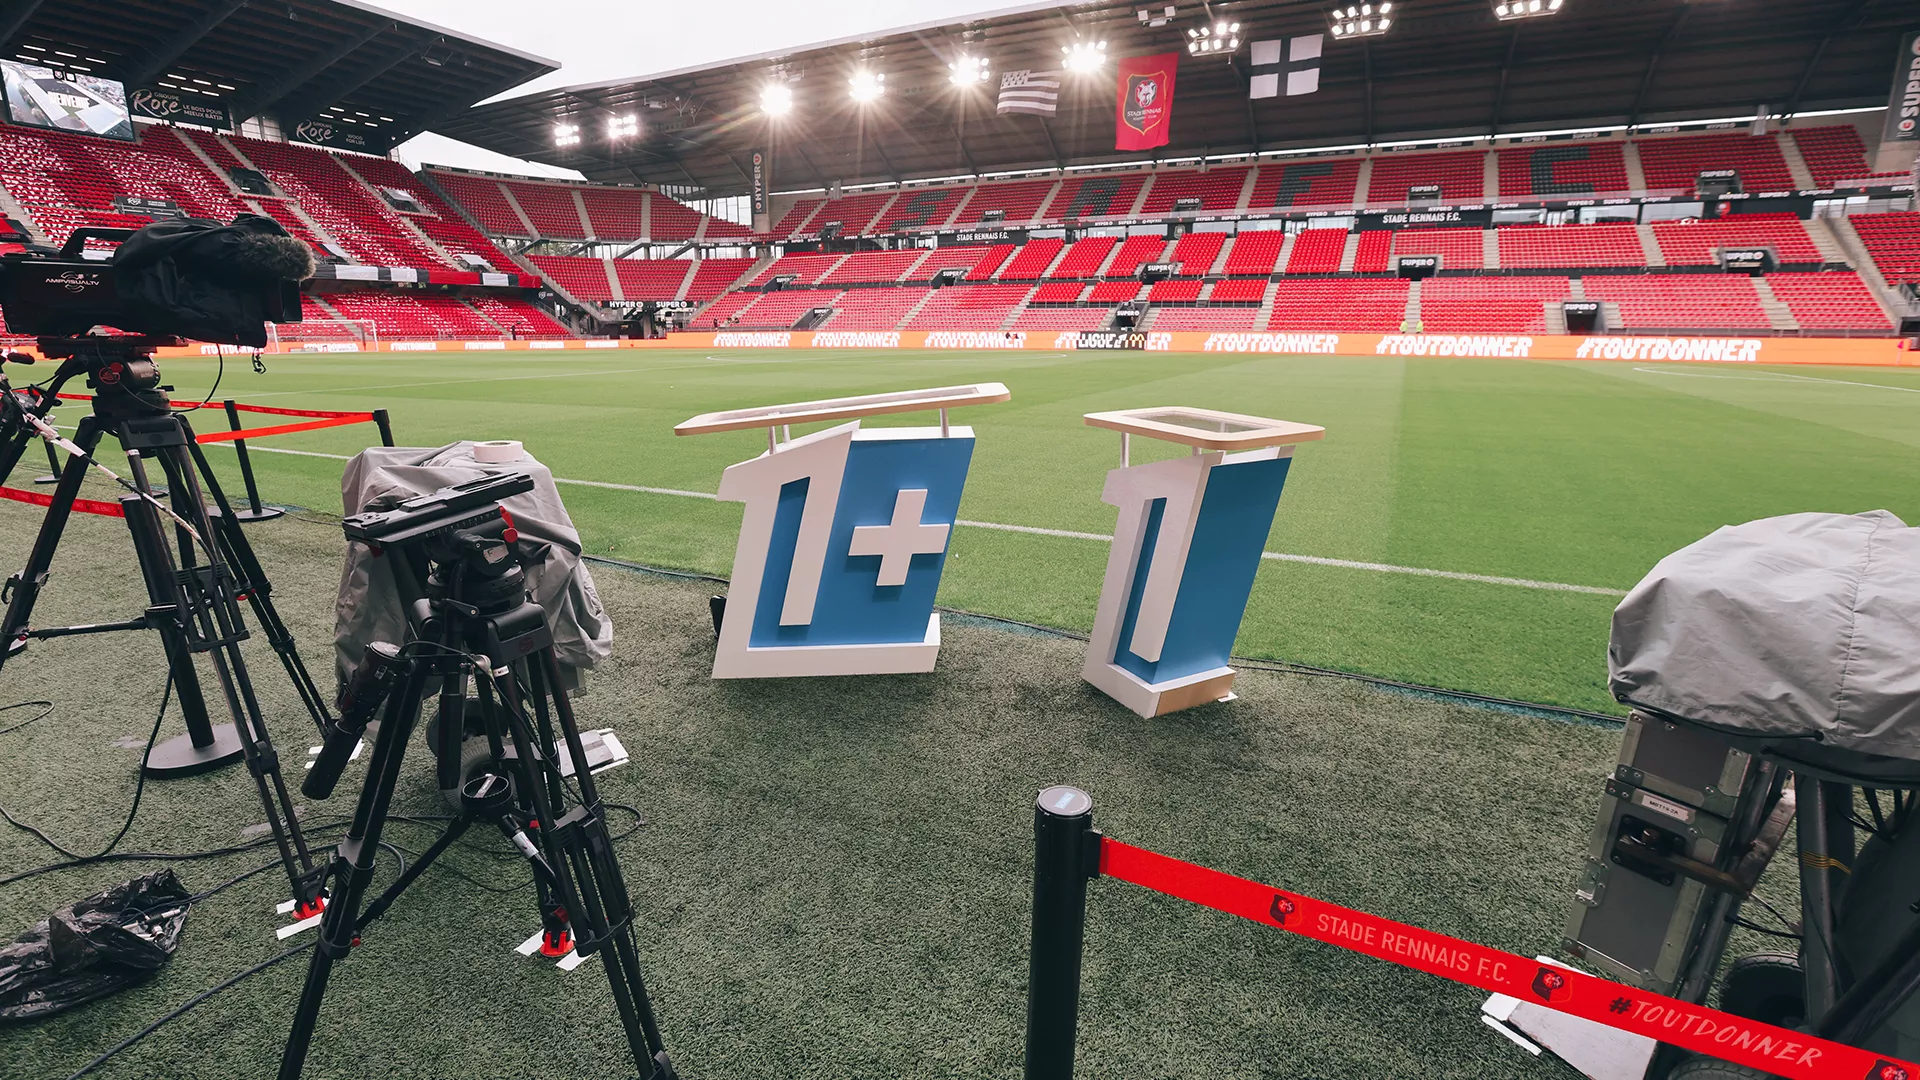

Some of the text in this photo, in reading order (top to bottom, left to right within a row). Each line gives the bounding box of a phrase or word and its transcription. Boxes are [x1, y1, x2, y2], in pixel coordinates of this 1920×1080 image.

[130, 89, 182, 117] Rose
[191, 105, 205, 113] BOIS
[296, 119, 334, 144] Rose
[1383, 212, 1461, 224] STADE RENNAIS F.C.
[714, 332, 790, 347] #TOUTDONNER
[812, 332, 900, 347] #TOUTDONNER
[1204, 334, 1338, 354] #TOUTDONNER
[1376, 336, 1532, 357] #TOUTDONNER
[1576, 338, 1762, 361] #TOUTDONNER
[1317, 913, 1511, 985] STADE RENNAIS F.C.
[1609, 996, 1823, 1069] #TOUTDONNER
